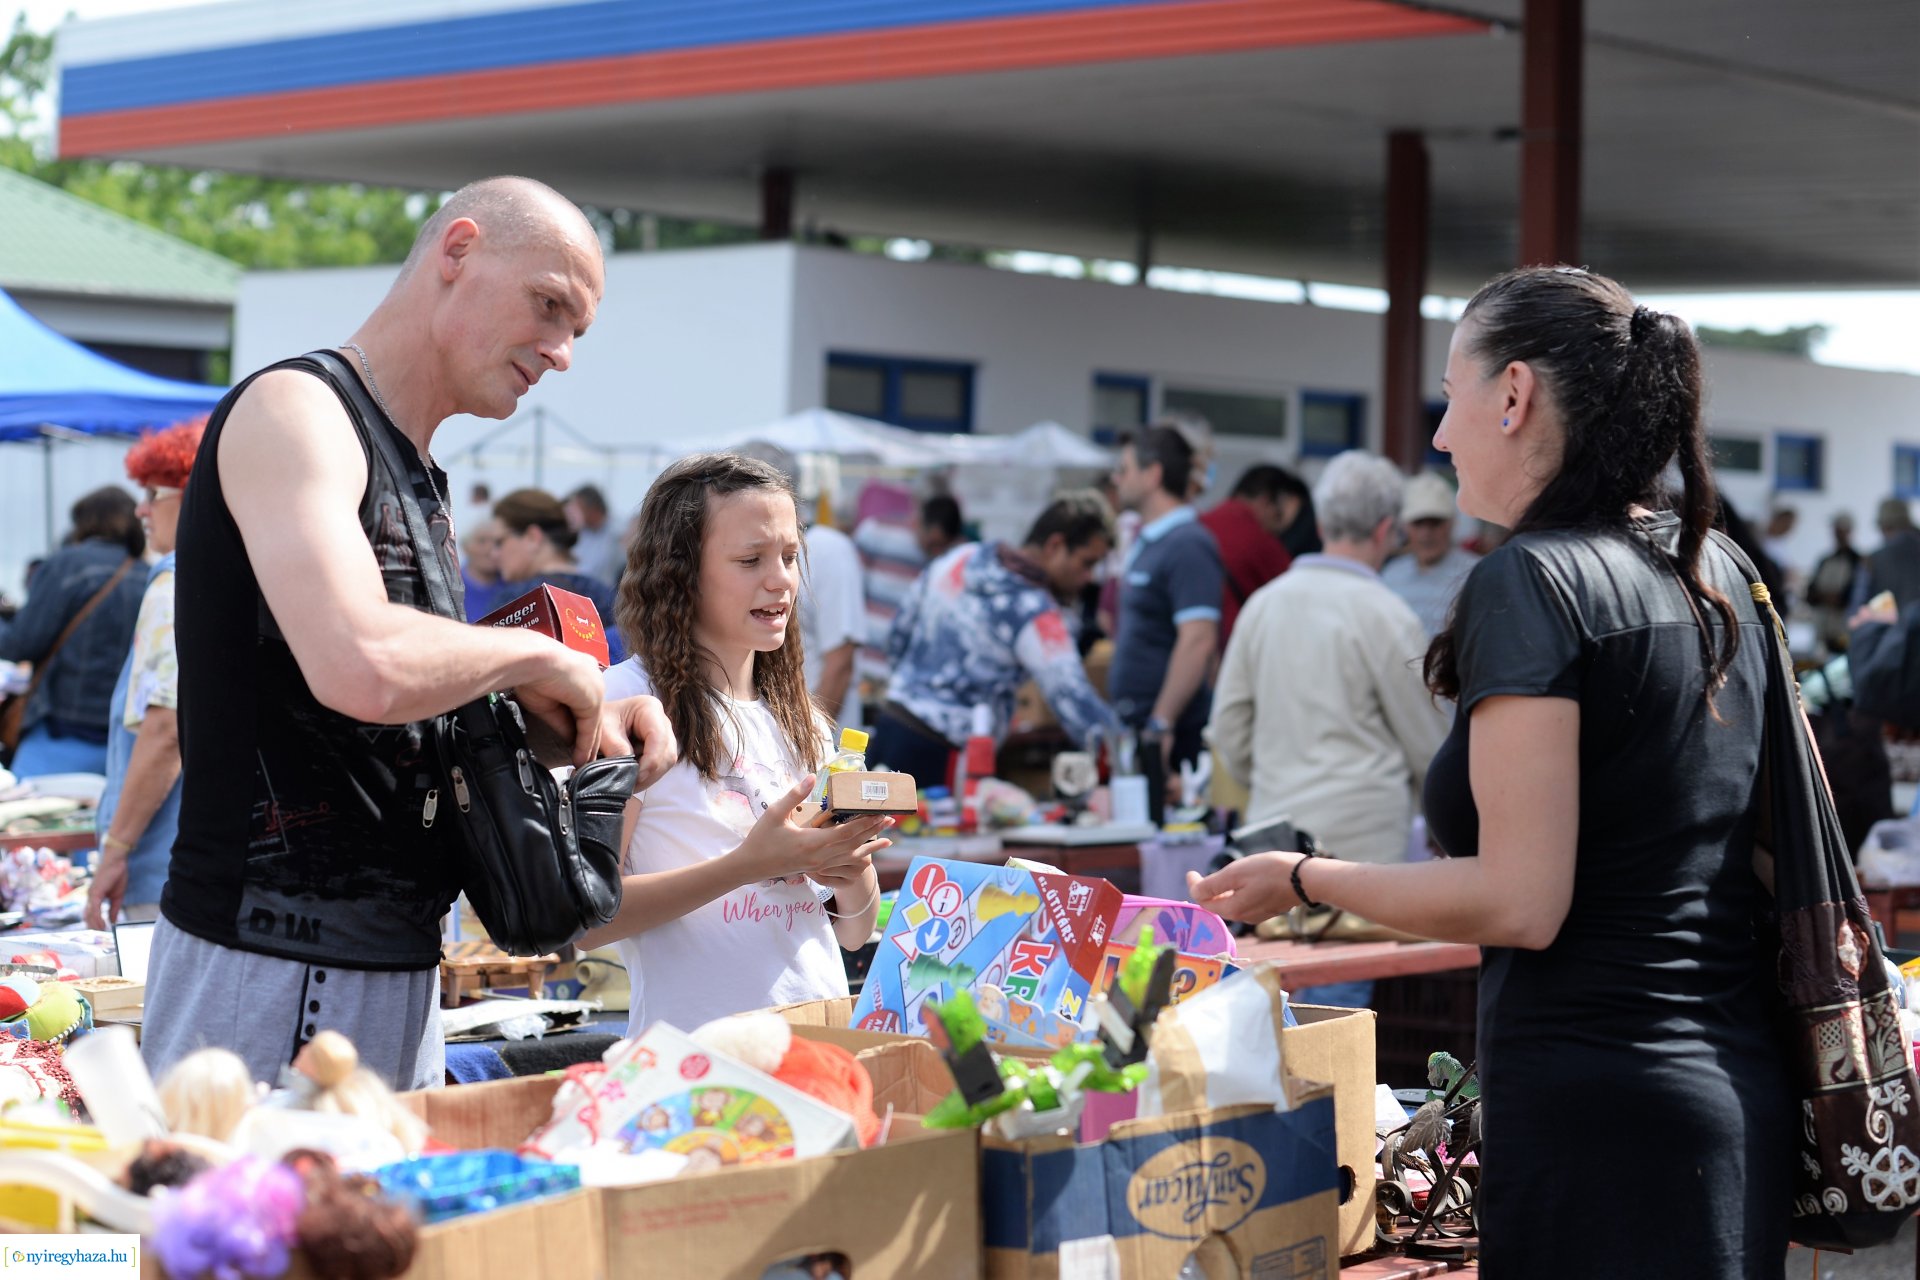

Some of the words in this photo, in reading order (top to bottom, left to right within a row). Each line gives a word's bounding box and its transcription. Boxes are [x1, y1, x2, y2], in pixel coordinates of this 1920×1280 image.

[489, 601, 537, 629] ssager
[723, 891, 782, 923] When
[785, 900, 817, 932] you
[1137, 1152, 1256, 1224] SanLucar
